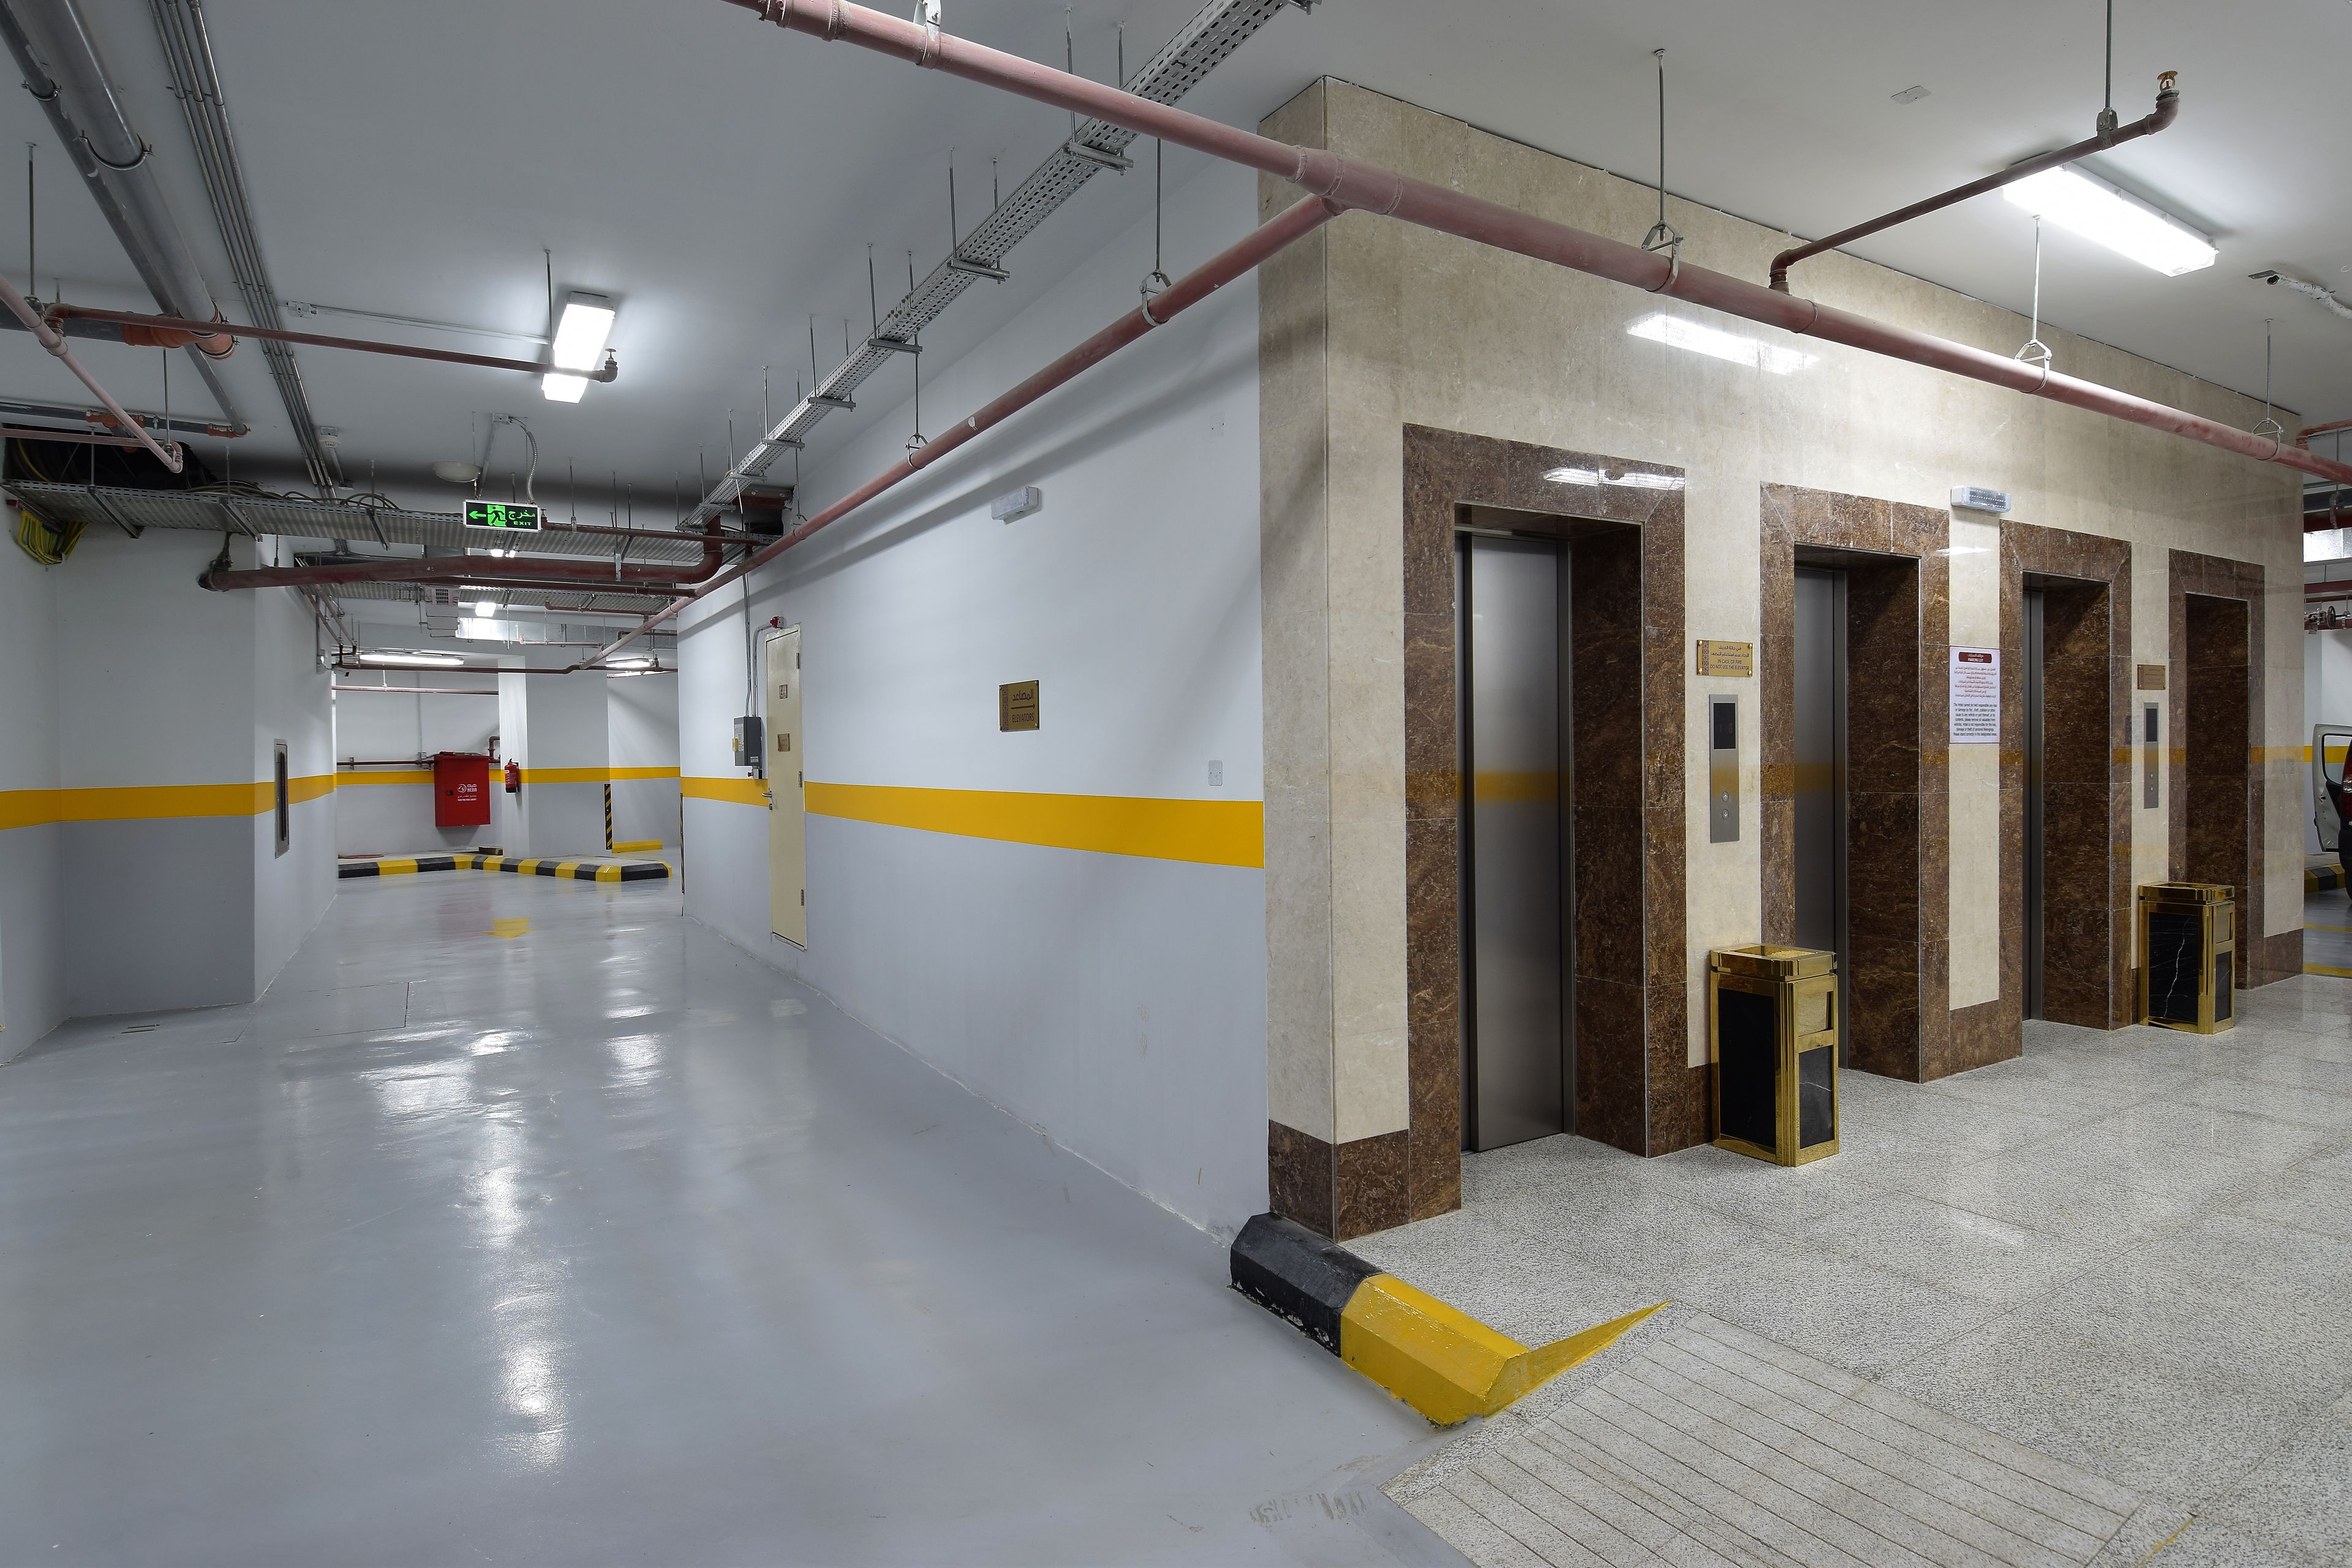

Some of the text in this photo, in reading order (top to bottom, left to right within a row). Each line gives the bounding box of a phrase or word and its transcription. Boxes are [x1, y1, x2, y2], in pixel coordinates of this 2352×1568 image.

[508, 510, 536, 520] مخرج
[1012, 688, 1034, 701] المصاعد
[1012, 712, 1035, 723] ELEVATORS
